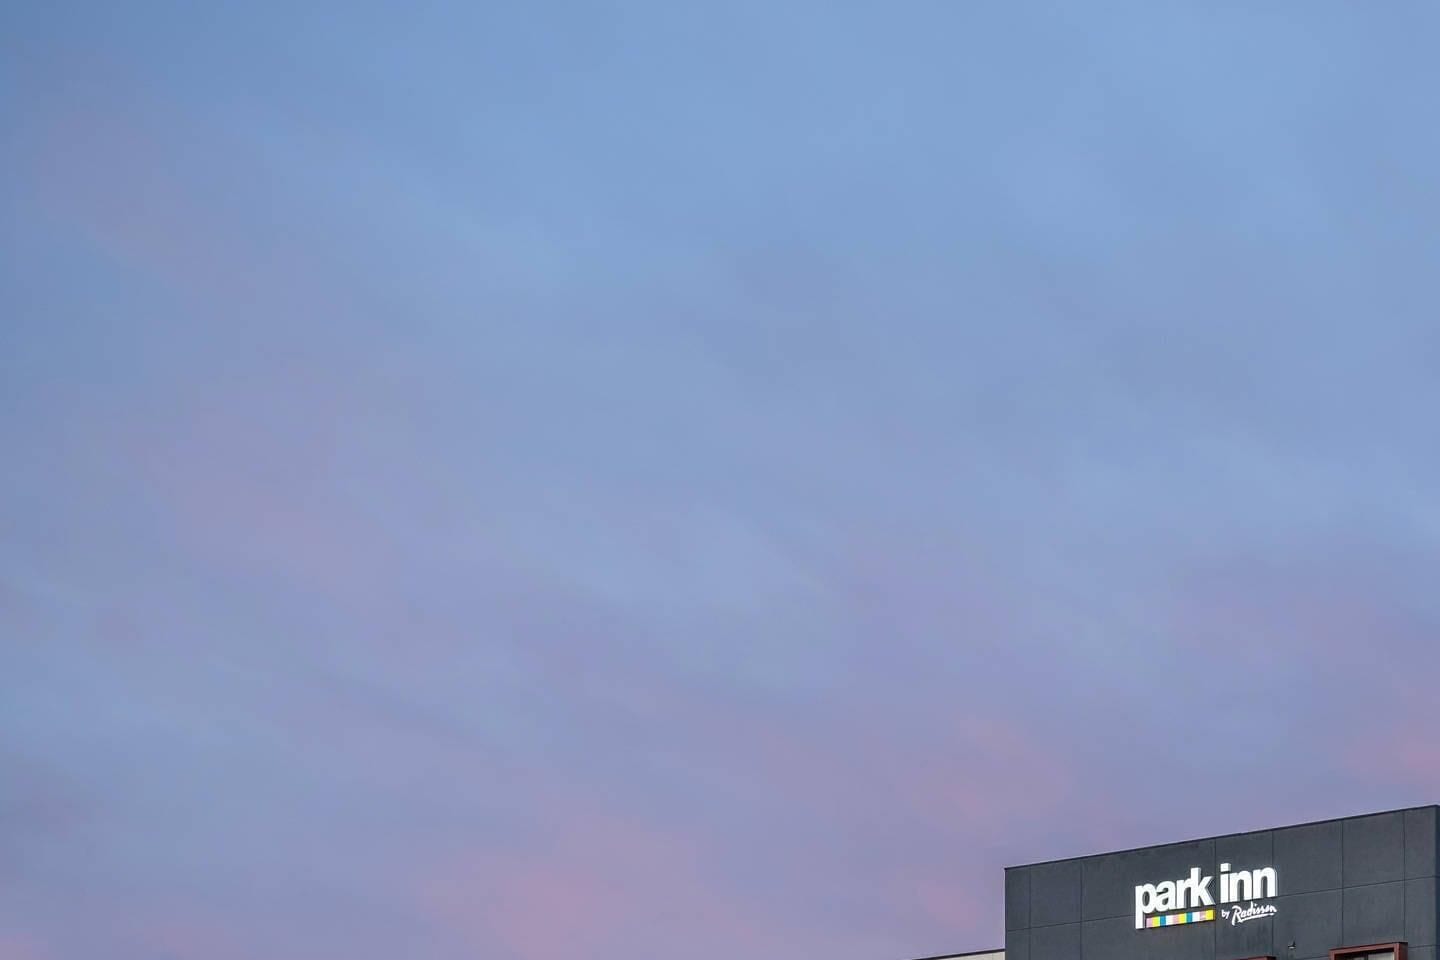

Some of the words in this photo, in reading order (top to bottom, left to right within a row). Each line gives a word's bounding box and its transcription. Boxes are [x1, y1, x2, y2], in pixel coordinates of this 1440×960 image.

[1135, 867, 1215, 929] park
[1219, 863, 1278, 903] inn
[1221, 909, 1230, 919] by
[1231, 901, 1277, 926] Radisson
